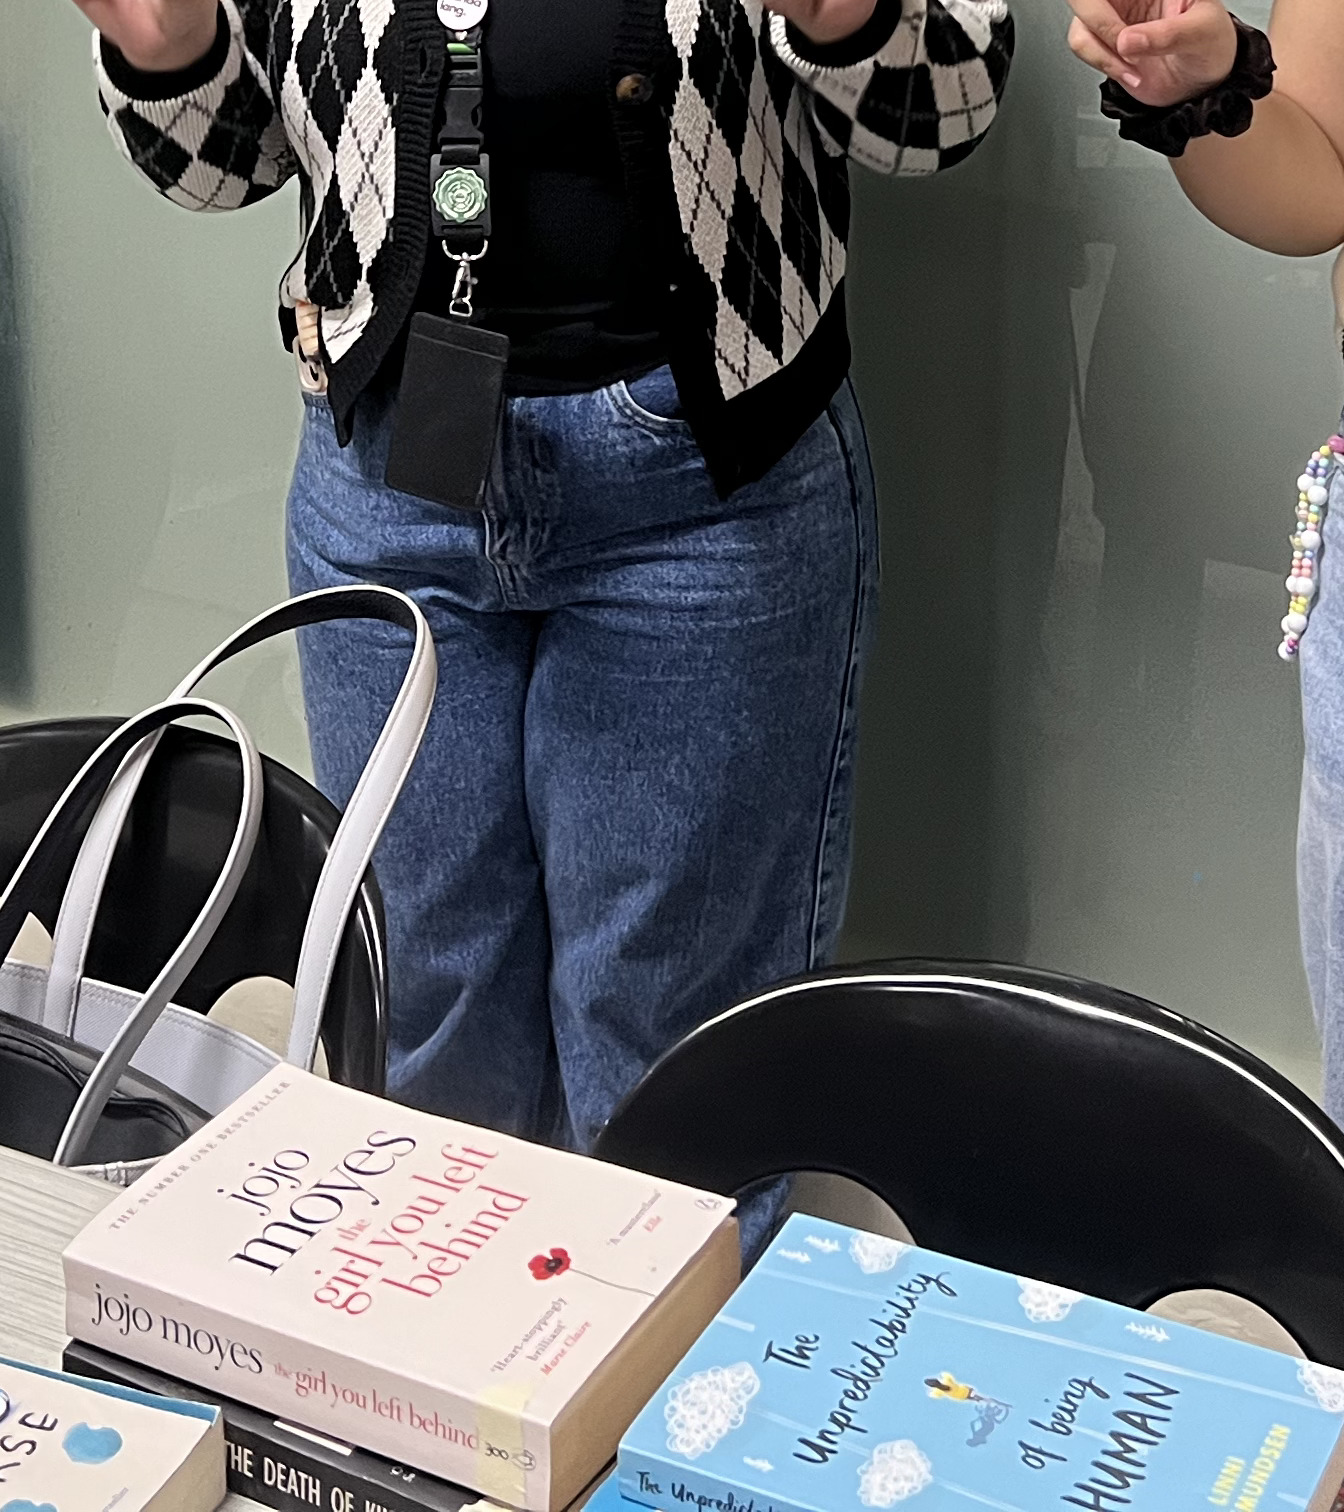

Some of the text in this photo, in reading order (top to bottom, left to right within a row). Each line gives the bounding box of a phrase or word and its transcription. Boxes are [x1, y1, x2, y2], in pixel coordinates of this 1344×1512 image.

[109, 1081, 291, 1230] THE NUMBER ONE BESTSELLER
[217, 1149, 310, 1217] jojo
[228, 1130, 416, 1276] moyes
[313, 1143, 499, 1315] girl you left
[337, 1219, 371, 1241] the
[379, 1184, 531, 1298] behind
[91, 1283, 153, 1336] jojo
[159, 1314, 263, 1374] moyes
[274, 1361, 293, 1379] the
[294, 1368, 327, 1397] girl
[330, 1383, 367, 1408] you
[372, 1389, 405, 1423] left
[762, 1333, 820, 1370] The
[792, 1271, 958, 1464] Unpredictability
[484, 1441, 509, 1461] 300
[1017, 1376, 1110, 1470] of being
[1060, 1372, 1181, 1512] HUMAN
[1231, 1424, 1291, 1512] MUNDSEN
[263, 1456, 321, 1507] DEATH
[330, 1486, 355, 1512] OF
[636, 1471, 663, 1495] The
[1207, 1455, 1246, 1506] LINNI
